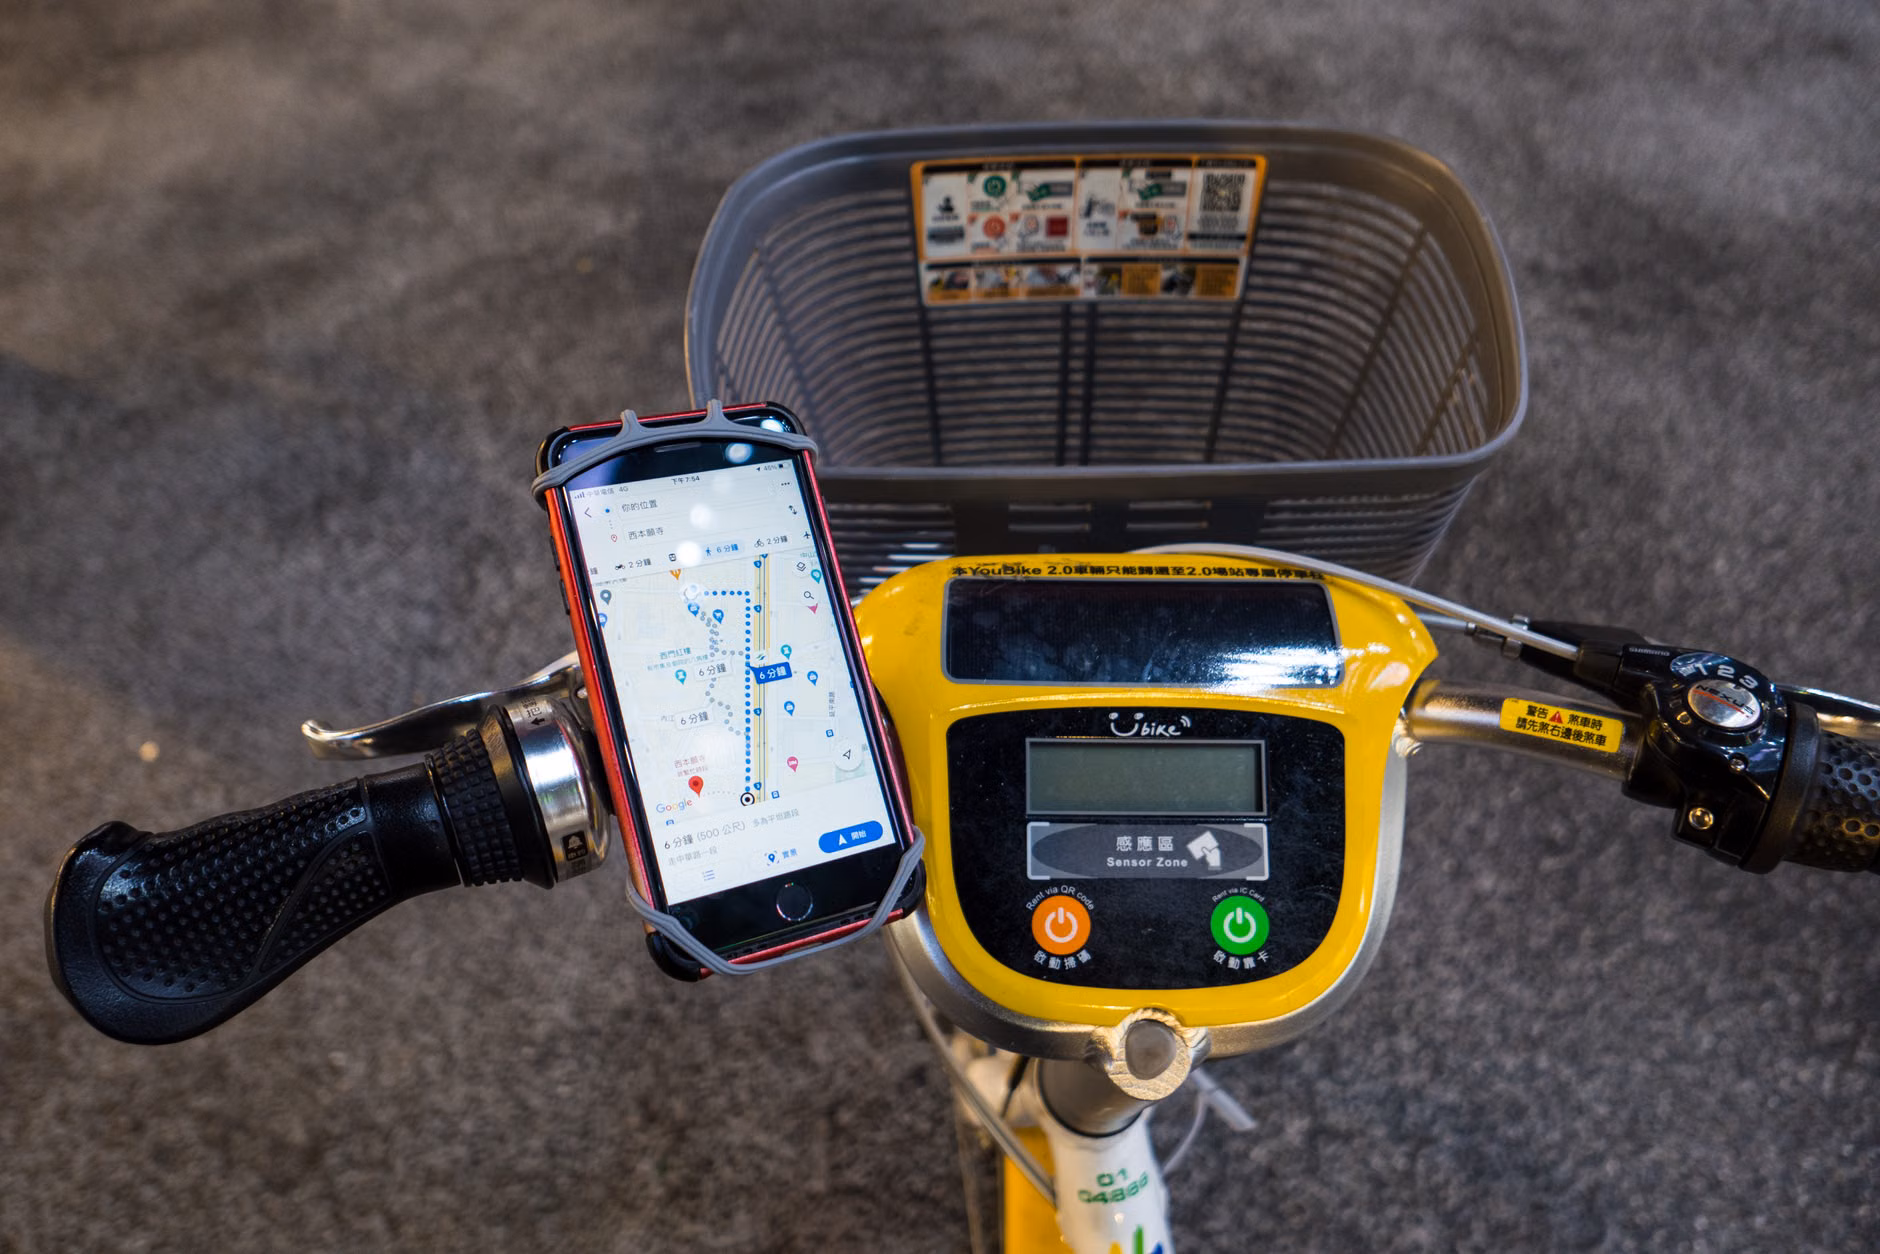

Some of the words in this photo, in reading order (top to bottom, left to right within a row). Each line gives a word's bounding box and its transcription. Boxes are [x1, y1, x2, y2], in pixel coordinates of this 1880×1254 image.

[621, 499, 658, 513] 你的位置
[628, 526, 664, 541] 西本願寺
[706, 663, 727, 676] 分鐘
[759, 671, 766, 680] 6
[767, 665, 787, 679] 分鐘
[1717, 664, 1735, 679] 2
[1738, 674, 1759, 689] 3
[680, 717, 687, 726] 6
[688, 711, 709, 725] 分鐘
[1526, 705, 1548, 719] 警告
[656, 799, 693, 813] Google
[664, 841, 671, 850] 6
[672, 833, 694, 849] 分鐘
[1116, 835, 1174, 852] 感應區
[1106, 856, 1152, 867] Sensor
[1156, 857, 1188, 867] Zone
[1025, 891, 1045, 911] Rent
[1044, 886, 1058, 895] via
[1060, 884, 1076, 895] QR
[1076, 892, 1095, 910] code
[1212, 890, 1228, 903] Rent
[1248, 889, 1265, 903] Card
[1096, 1168, 1128, 1187] 01
